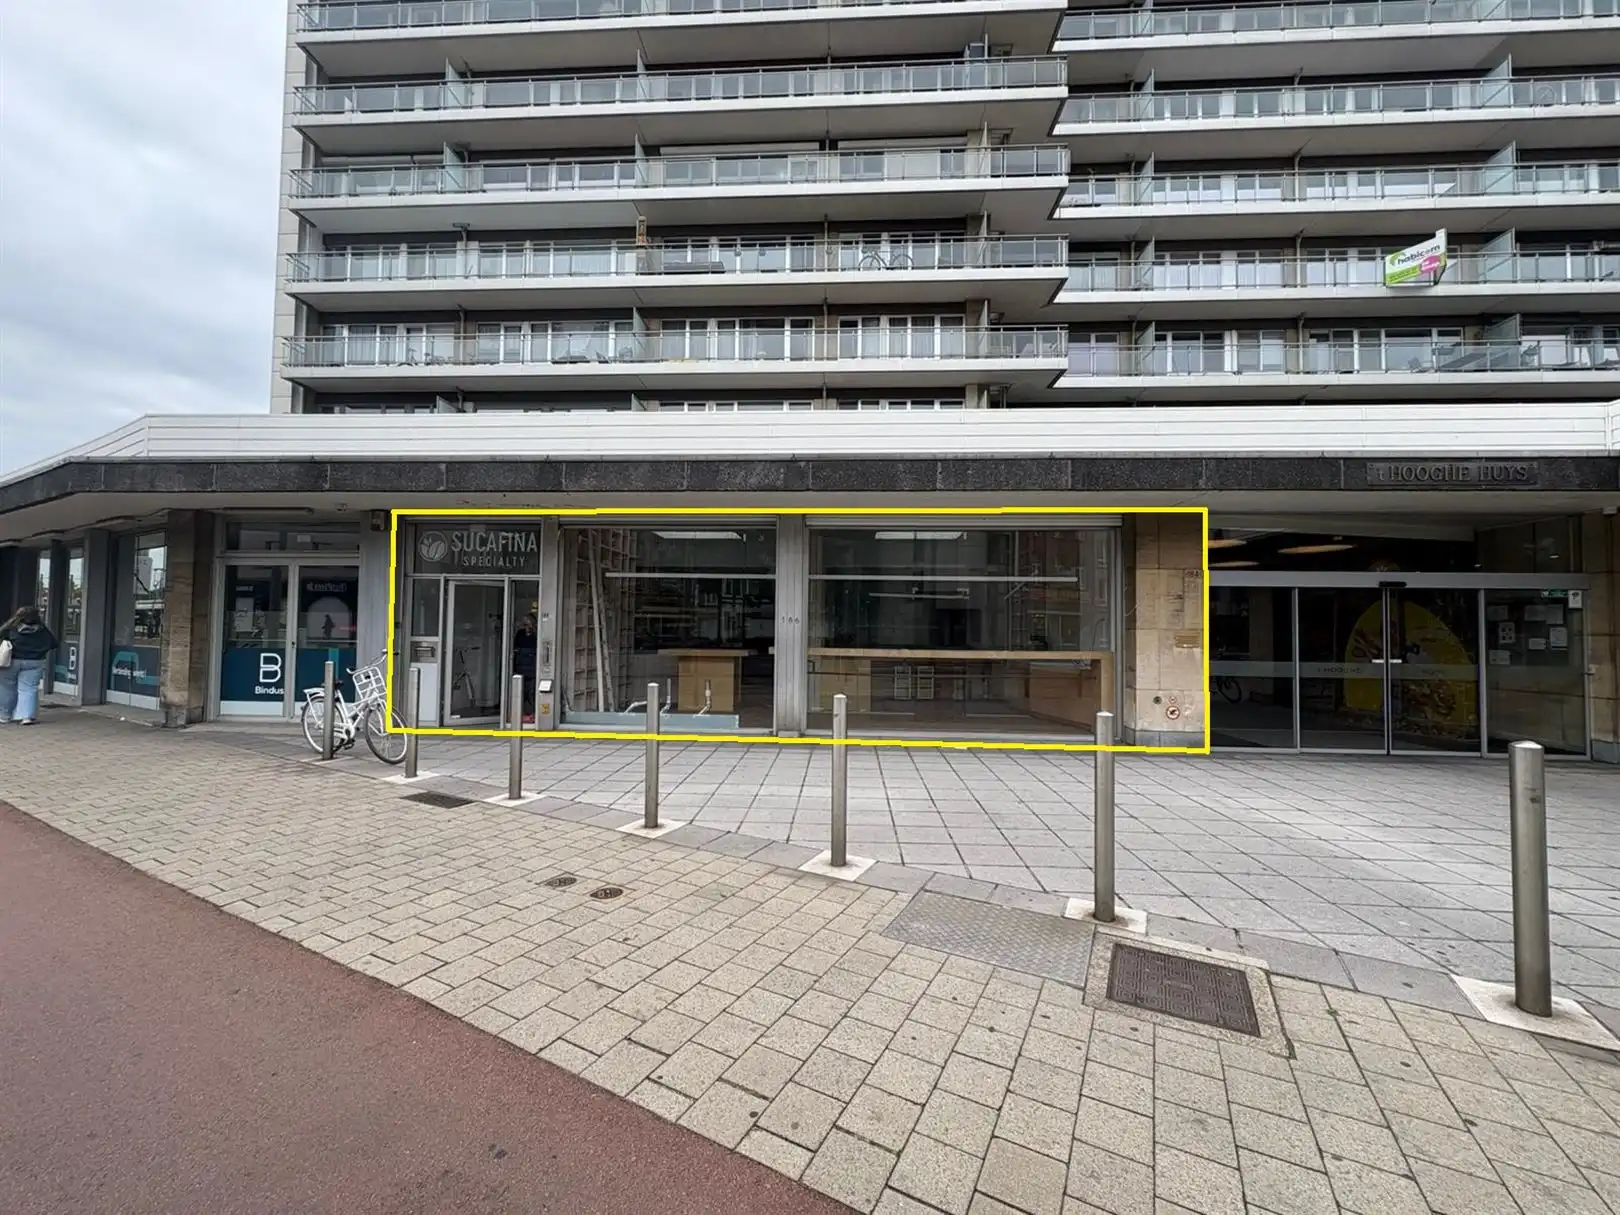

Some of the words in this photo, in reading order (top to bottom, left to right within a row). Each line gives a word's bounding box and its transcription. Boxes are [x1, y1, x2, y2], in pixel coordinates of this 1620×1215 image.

[1389, 464, 1472, 481] HOOGHE
[1478, 464, 1529, 481] HUYS
[451, 531, 537, 552] SUCAFINA
[463, 556, 525, 567] SPECIALTY
[255, 686, 284, 694] Bindus
